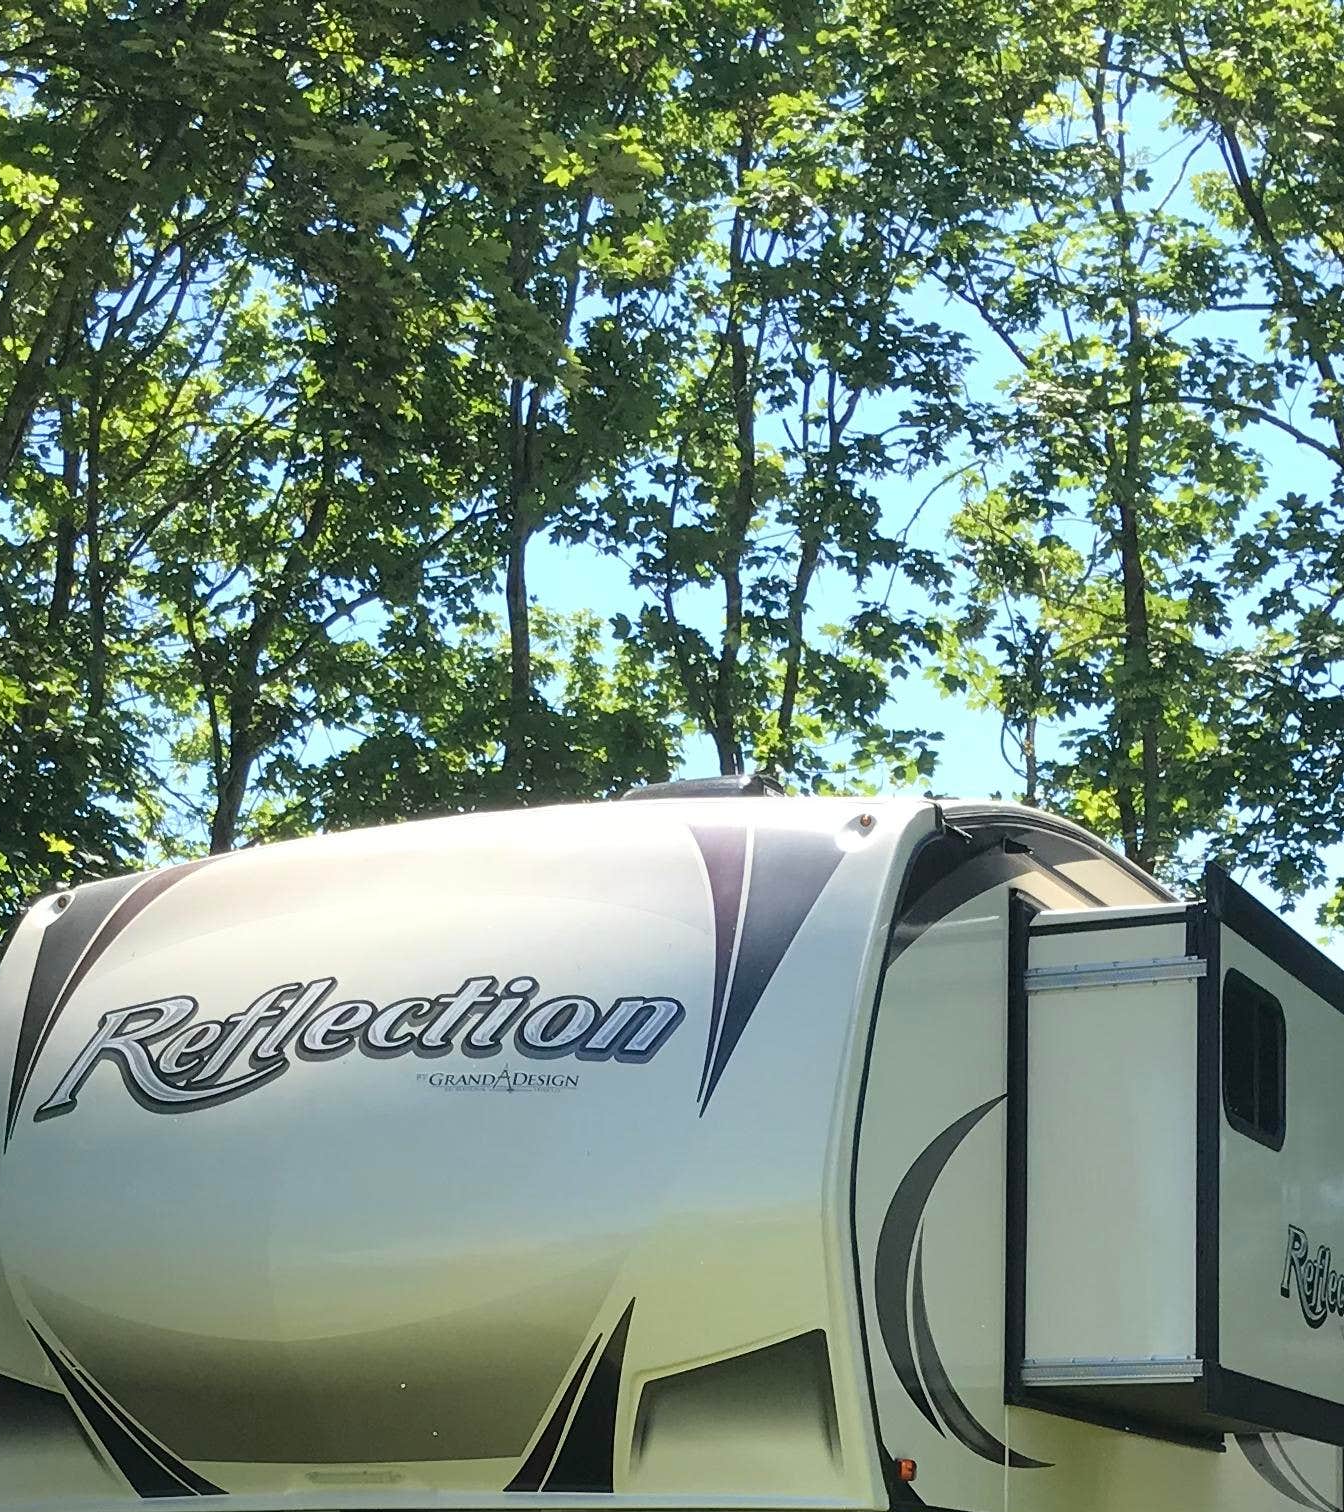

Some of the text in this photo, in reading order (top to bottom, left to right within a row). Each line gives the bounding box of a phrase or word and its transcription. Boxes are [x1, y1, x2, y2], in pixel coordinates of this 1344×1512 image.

[33, 976, 686, 1122] Reflection
[428, 1072, 496, 1087] GRAND
[512, 1072, 580, 1087] DESIGN
